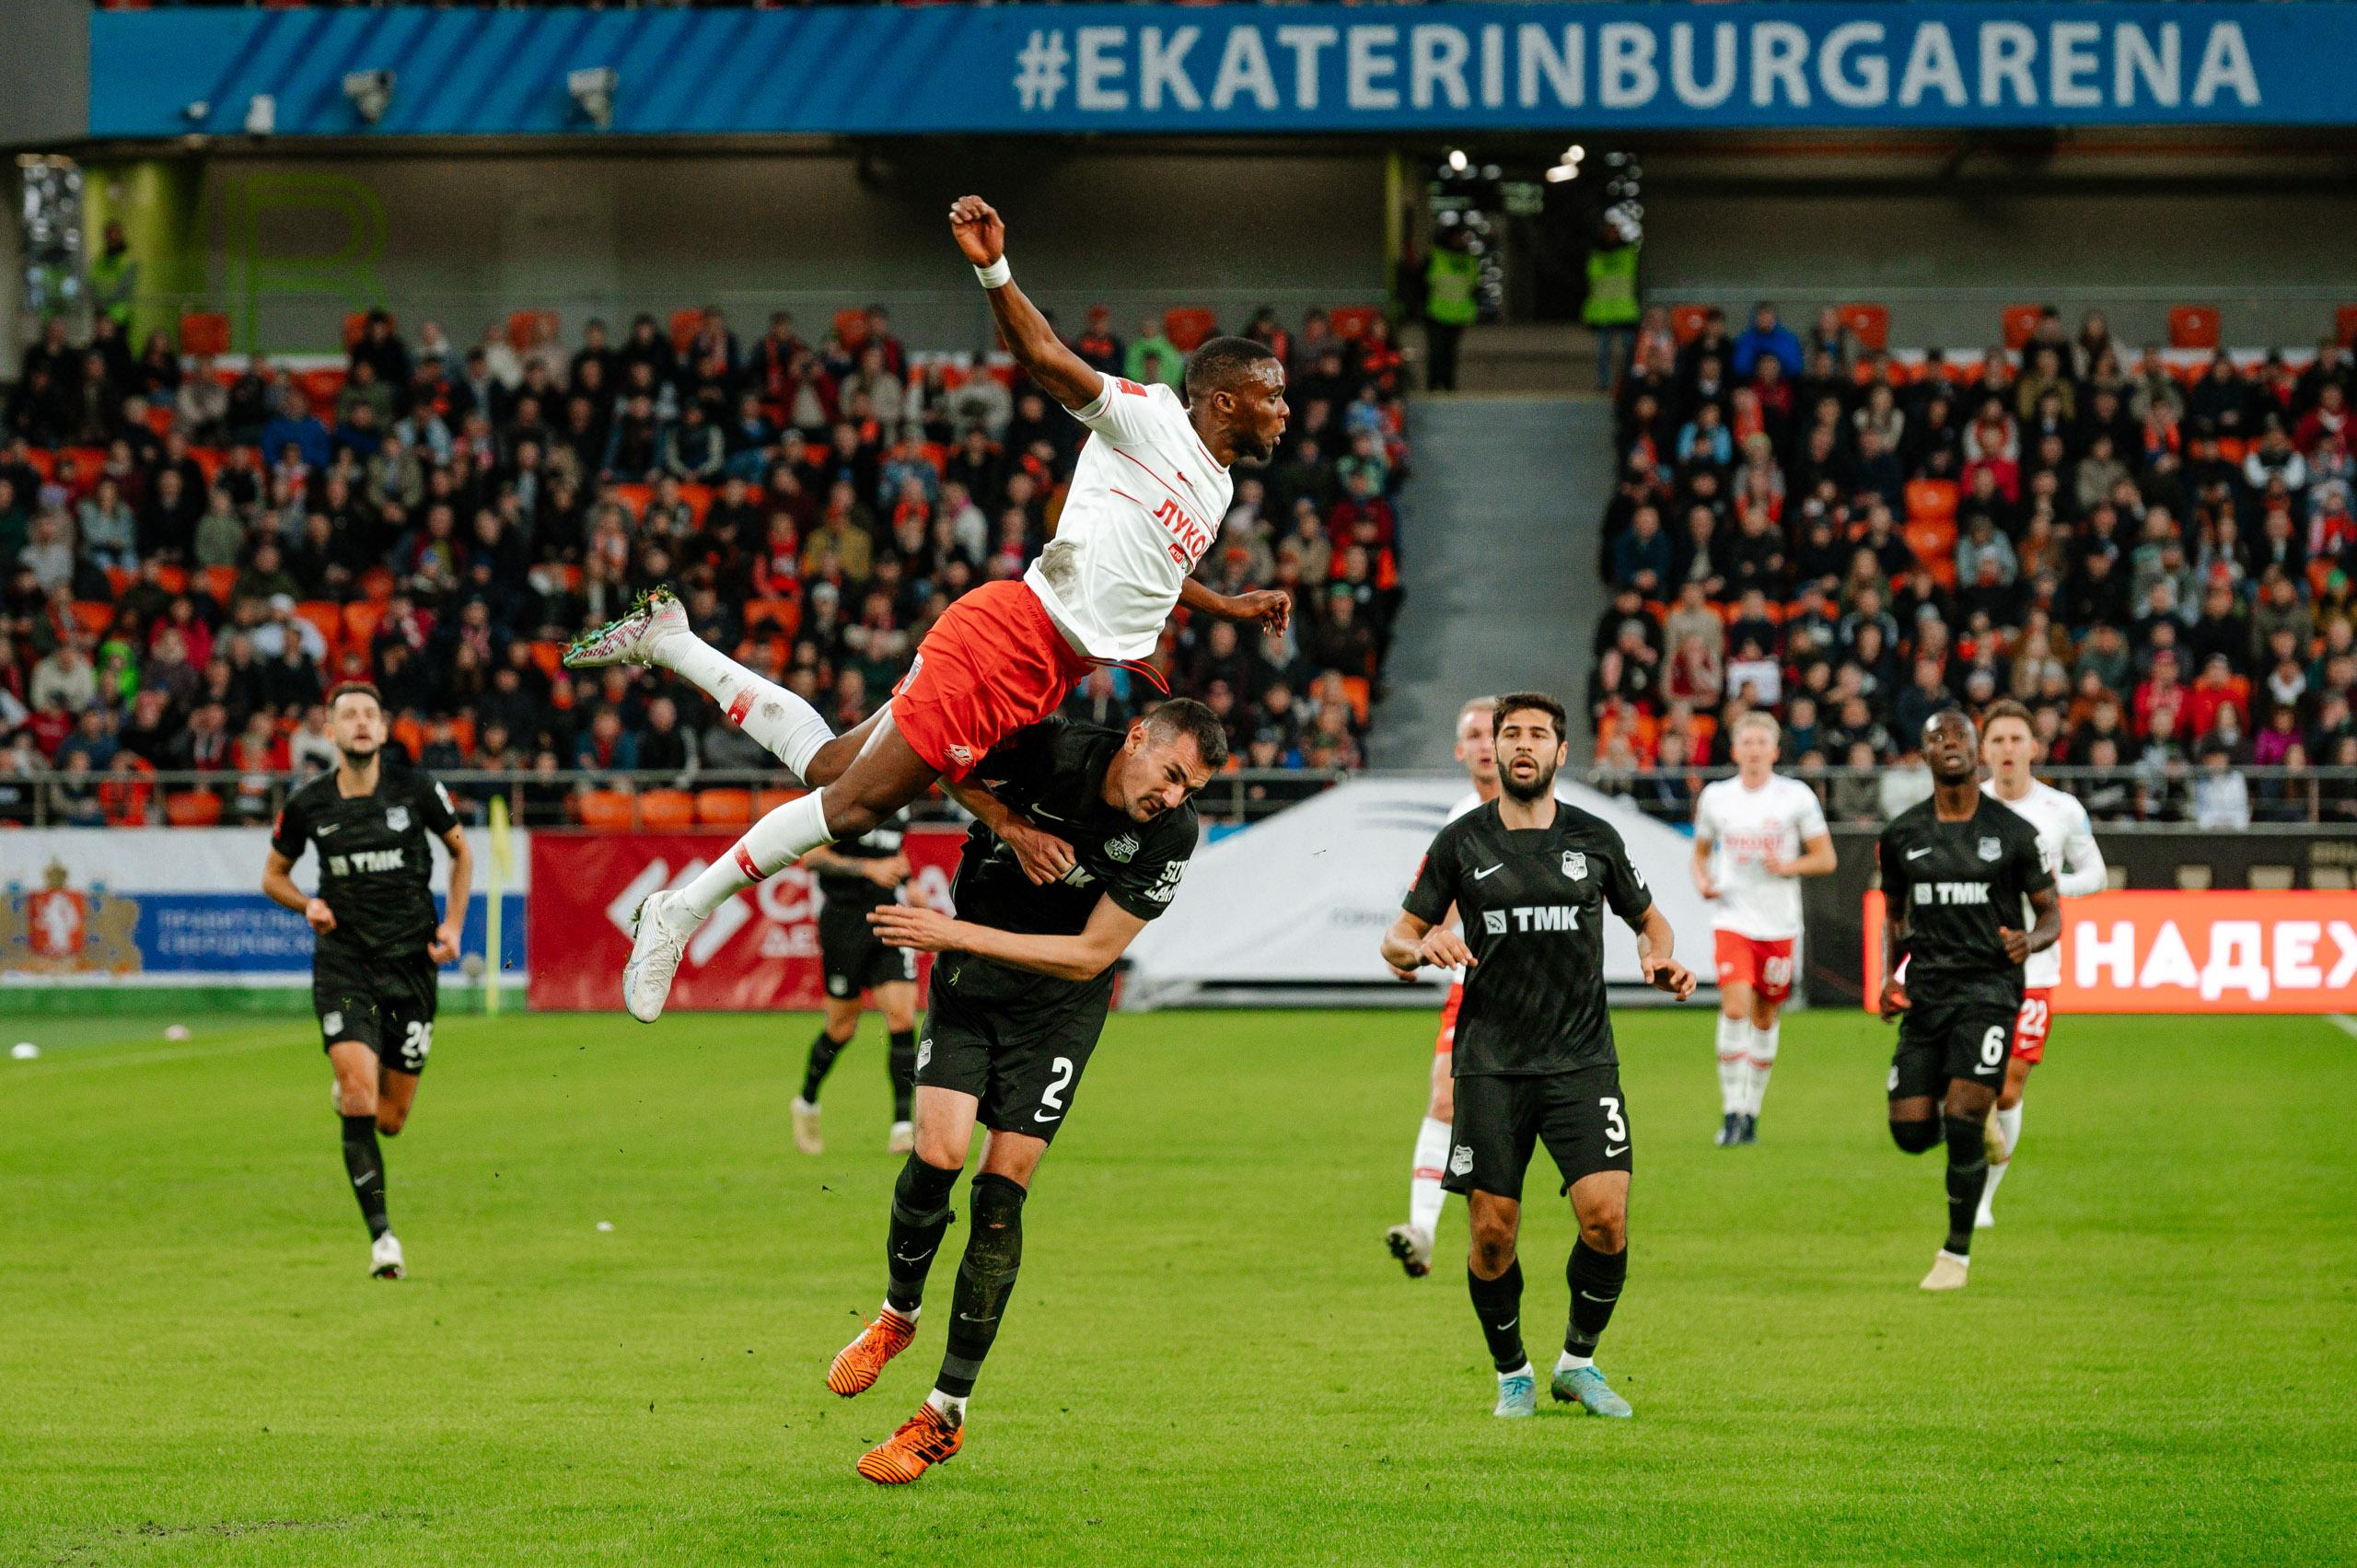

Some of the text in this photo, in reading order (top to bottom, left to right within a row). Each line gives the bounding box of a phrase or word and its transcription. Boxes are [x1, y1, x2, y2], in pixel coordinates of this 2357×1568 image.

[1014, 20, 2262, 112] #EKATERINBURGARENA
[1152, 497, 1213, 560] ЛУКО
[2018, 997, 2048, 1038] 22
[1981, 1025, 2005, 1066] 6
[1040, 1056, 1074, 1110] 2
[1599, 1097, 1626, 1142] 3
